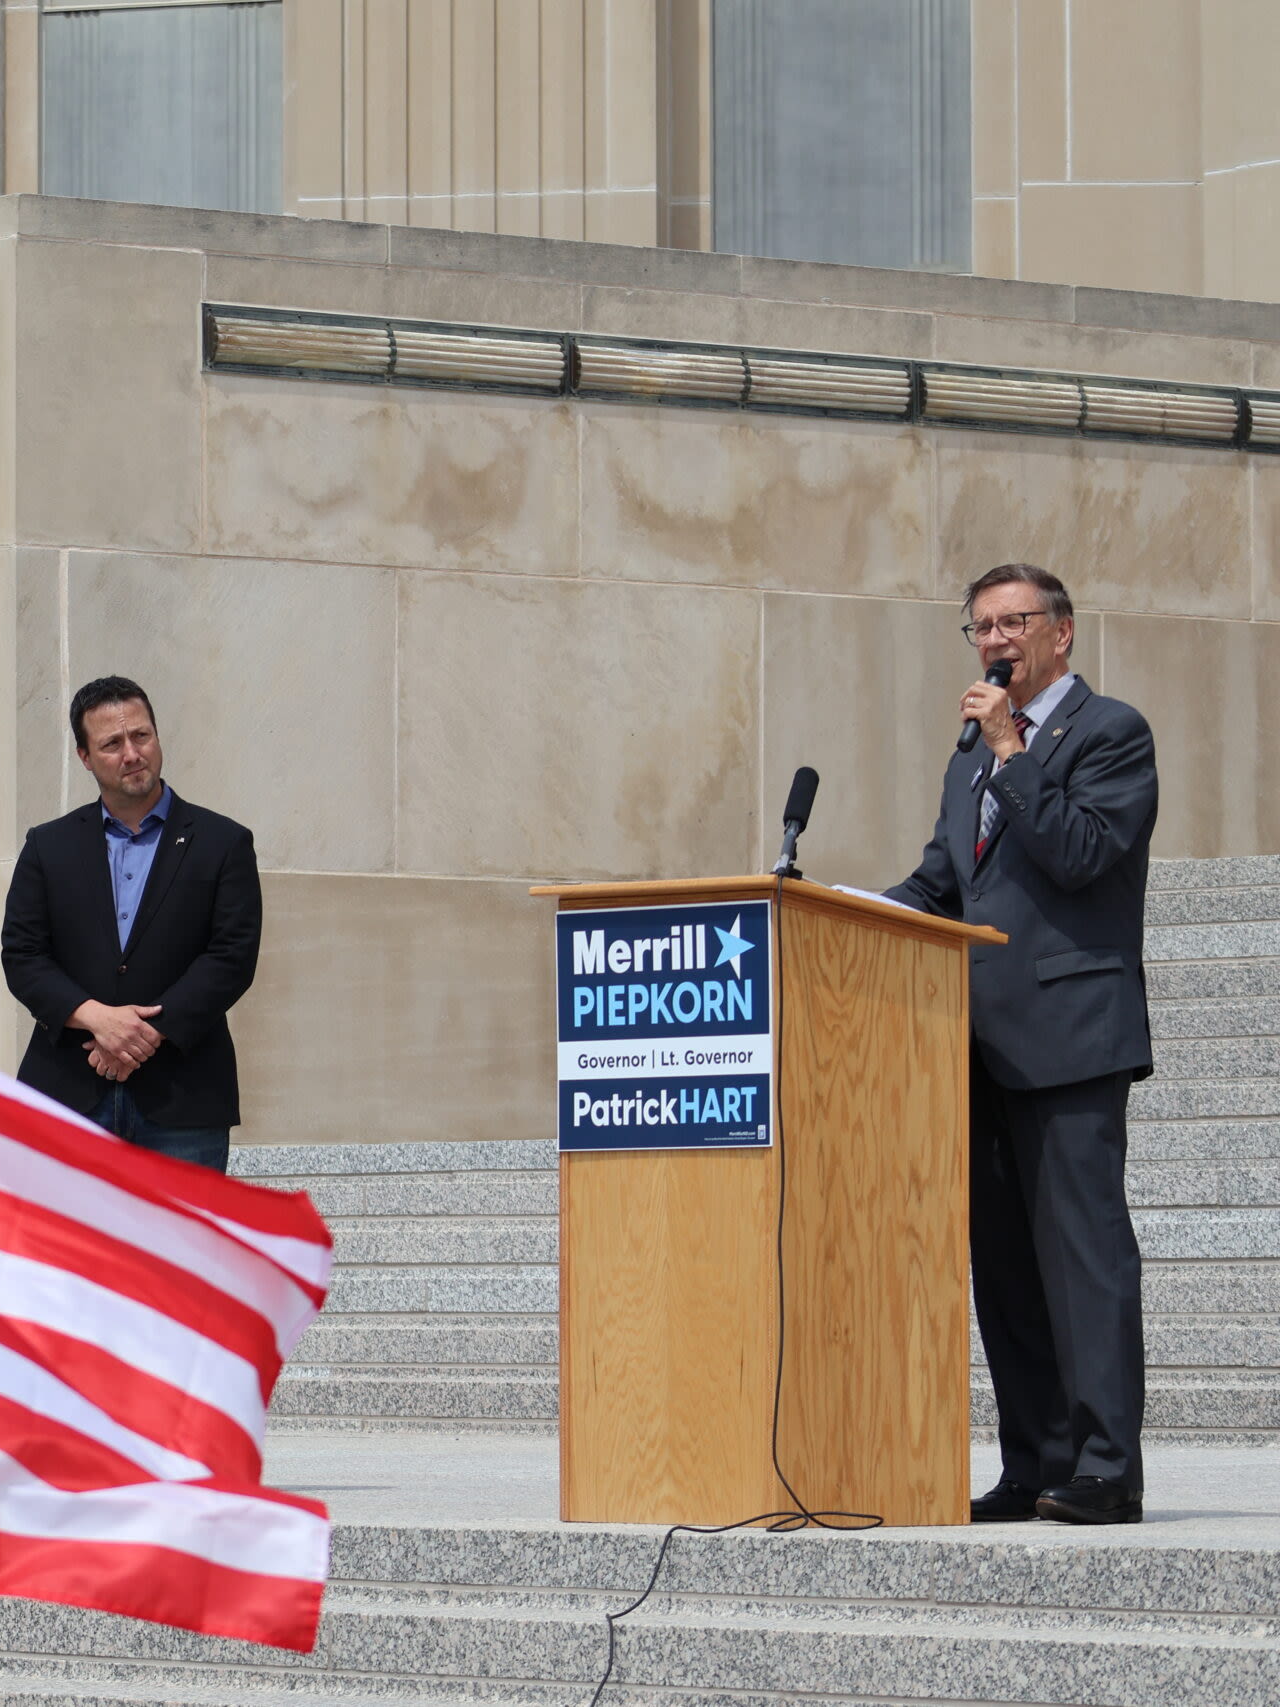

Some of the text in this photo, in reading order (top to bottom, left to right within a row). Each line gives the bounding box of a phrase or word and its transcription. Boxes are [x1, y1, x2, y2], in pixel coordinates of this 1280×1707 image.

[573, 924, 706, 975] Merrill
[574, 979, 753, 1027] PIEPKORN
[577, 1053, 646, 1069] Governor
[661, 1051, 679, 1066] Lt.
[684, 1050, 753, 1066] Governor
